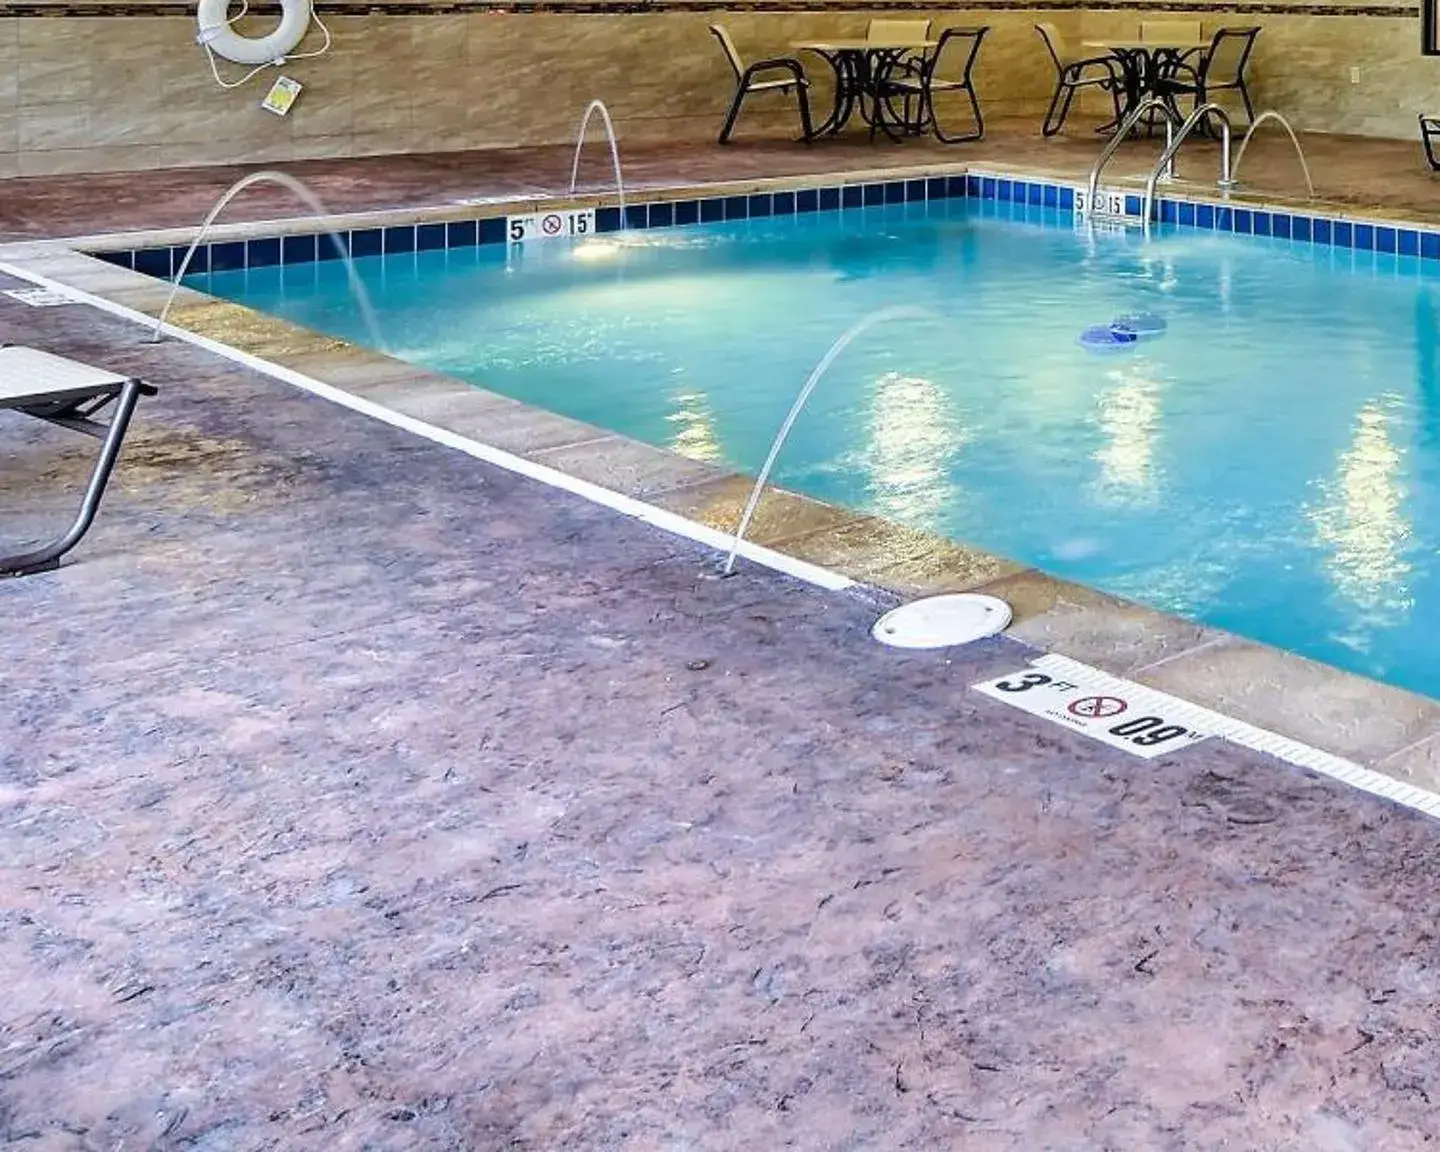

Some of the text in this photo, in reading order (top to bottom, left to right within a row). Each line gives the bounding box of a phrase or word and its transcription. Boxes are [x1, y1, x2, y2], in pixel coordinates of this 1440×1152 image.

[1076, 192, 1084, 210] 5
[511, 219, 524, 240] 5
[995, 673, 1052, 692] 3
